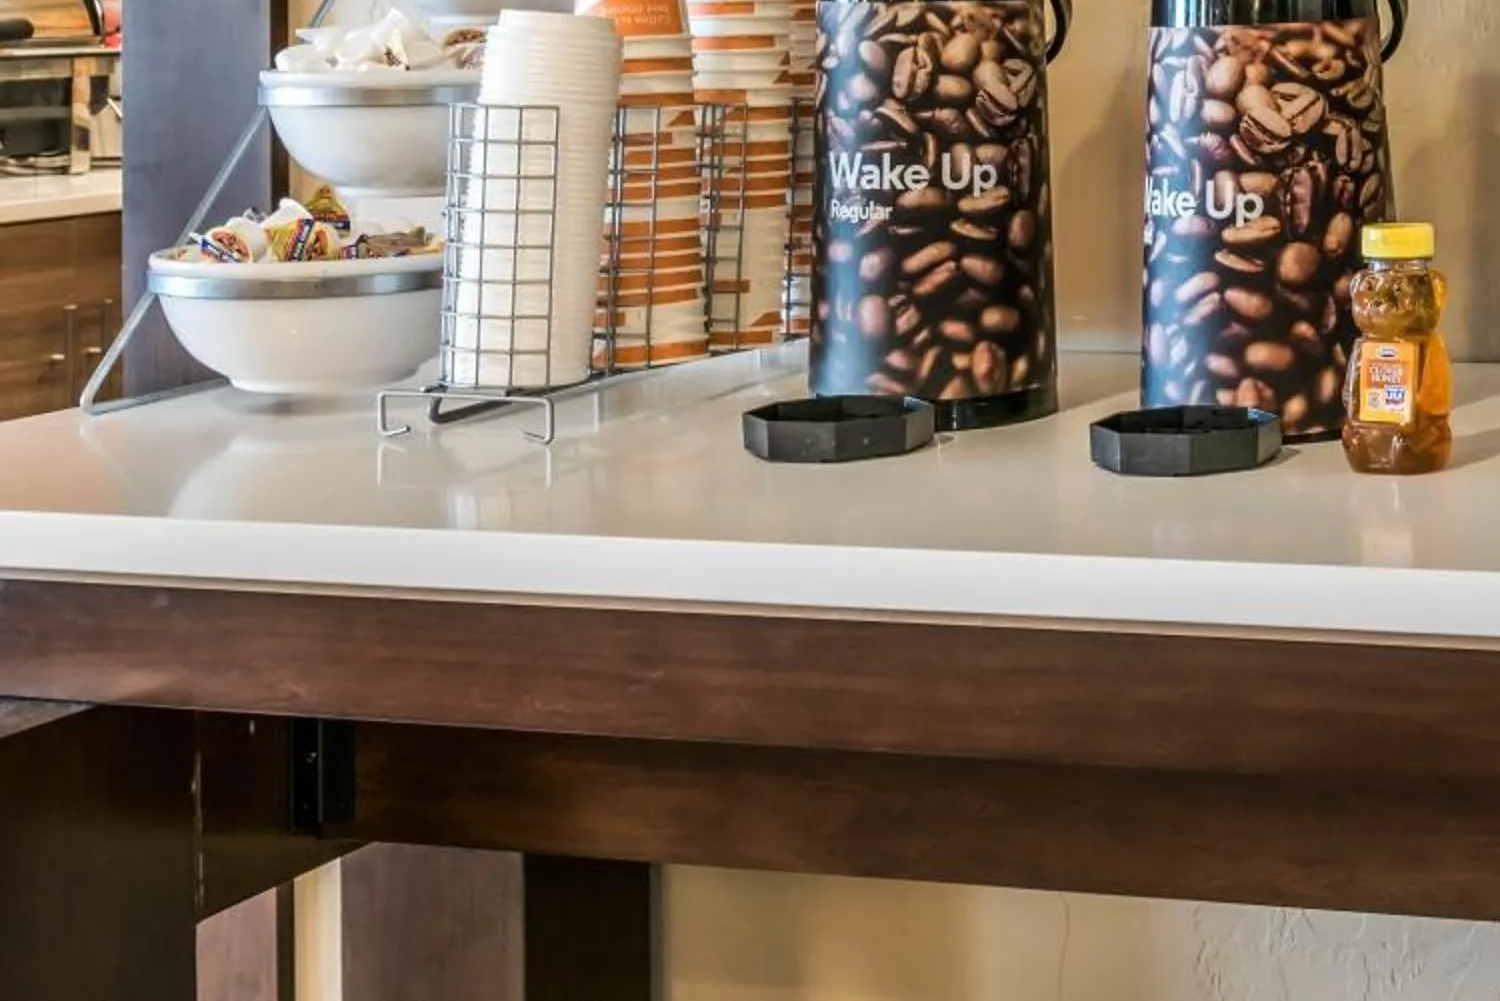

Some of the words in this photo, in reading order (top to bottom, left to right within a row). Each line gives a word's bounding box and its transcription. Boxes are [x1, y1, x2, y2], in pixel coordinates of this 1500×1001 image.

[828, 151, 930, 190] Wake
[941, 153, 997, 197] Up
[830, 200, 893, 222] Regular
[1205, 179, 1265, 227] Up
